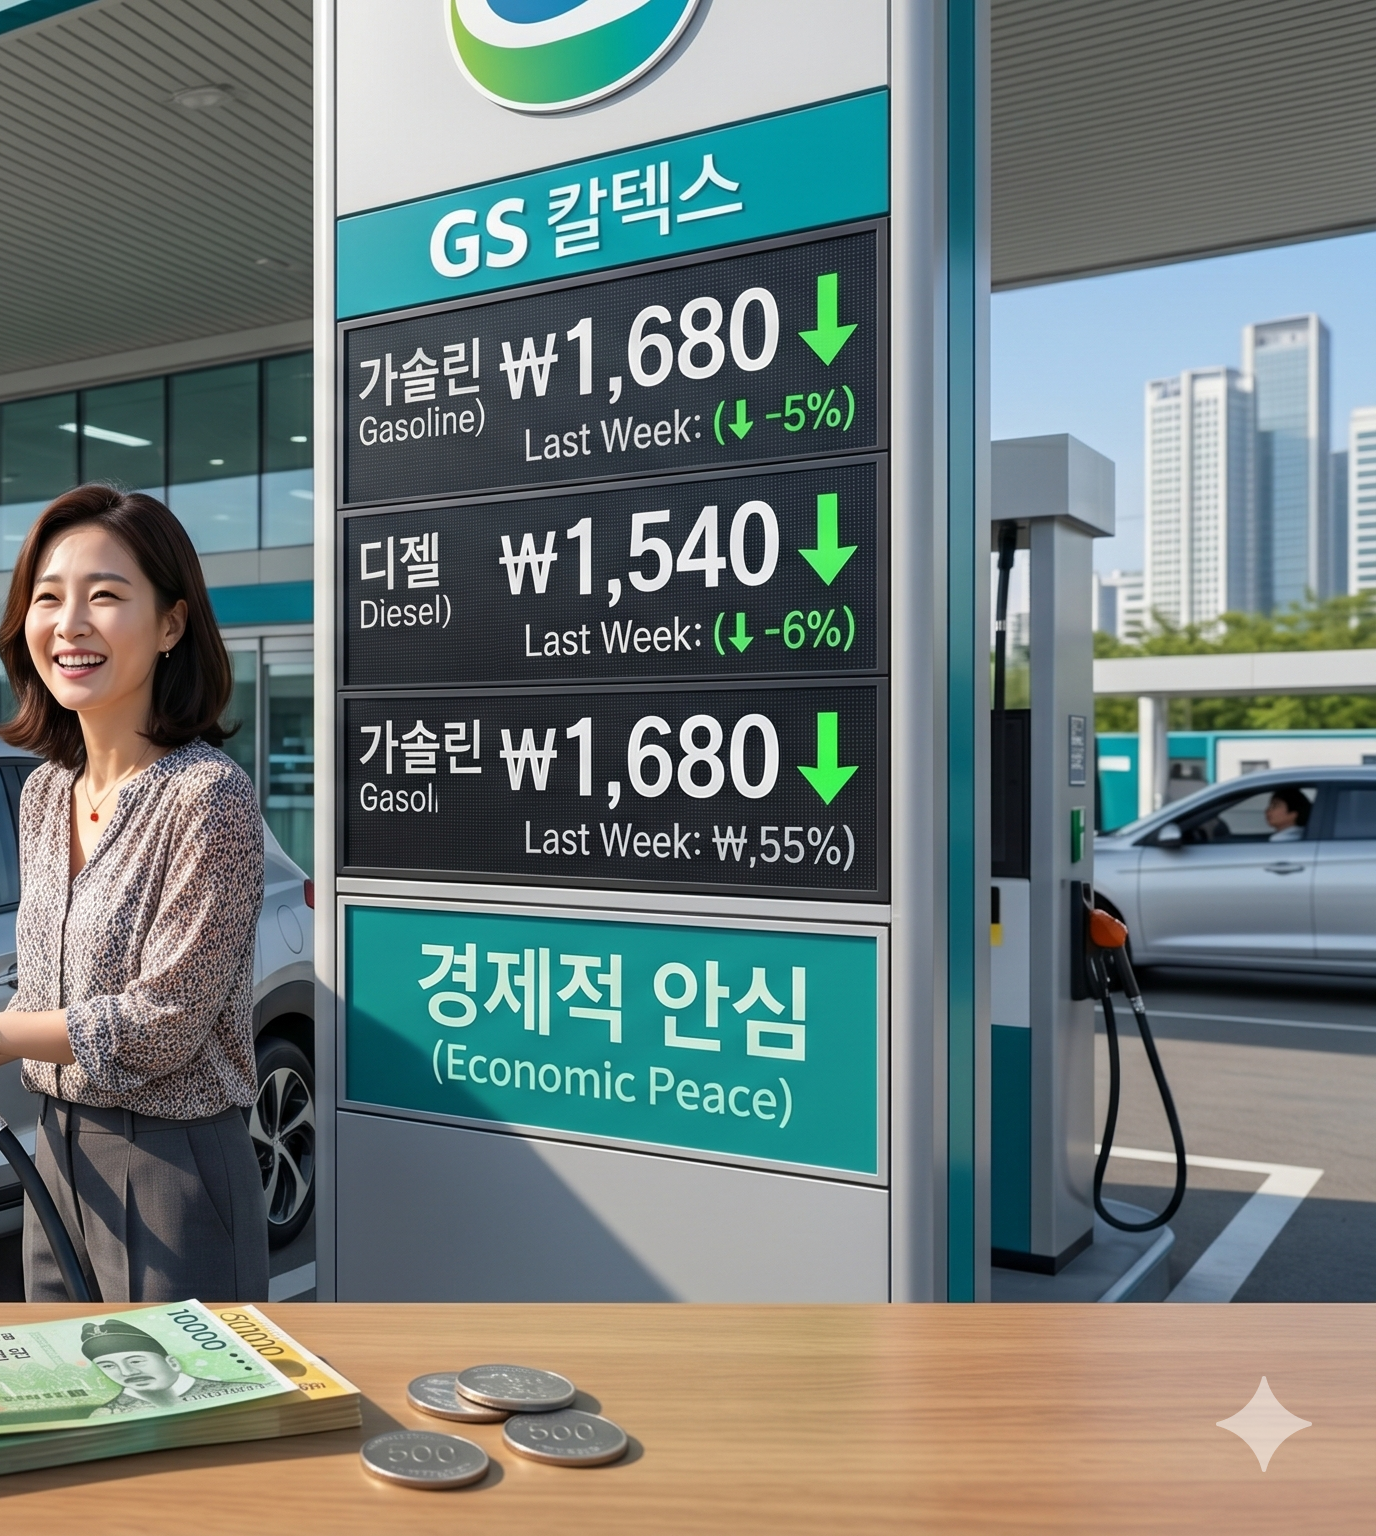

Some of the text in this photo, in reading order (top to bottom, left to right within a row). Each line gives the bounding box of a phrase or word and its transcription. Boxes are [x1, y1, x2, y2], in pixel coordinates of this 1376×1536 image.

[429, 153, 744, 278] GS 칼텍스
[359, 286, 780, 407] 가솔린 ₩1,680
[359, 398, 485, 447] Gasoline)
[525, 424, 591, 462] Last
[600, 408, 702, 453] Week:
[360, 500, 780, 605] 디젤 ₩1,540
[360, 595, 452, 629] Diesel)
[525, 624, 591, 657] Last
[600, 616, 702, 654] Week:
[359, 713, 780, 810] 가솔린 ₩1,680
[525, 821, 855, 872] Last Week: ₩,55%)
[417, 943, 807, 1062] 경제적 안심
[432, 1039, 792, 1129] (Economic Peace)
[166, 1308, 227, 1351] 10000
[388, 1444, 455, 1463] 500
[529, 1422, 595, 1442] 500
